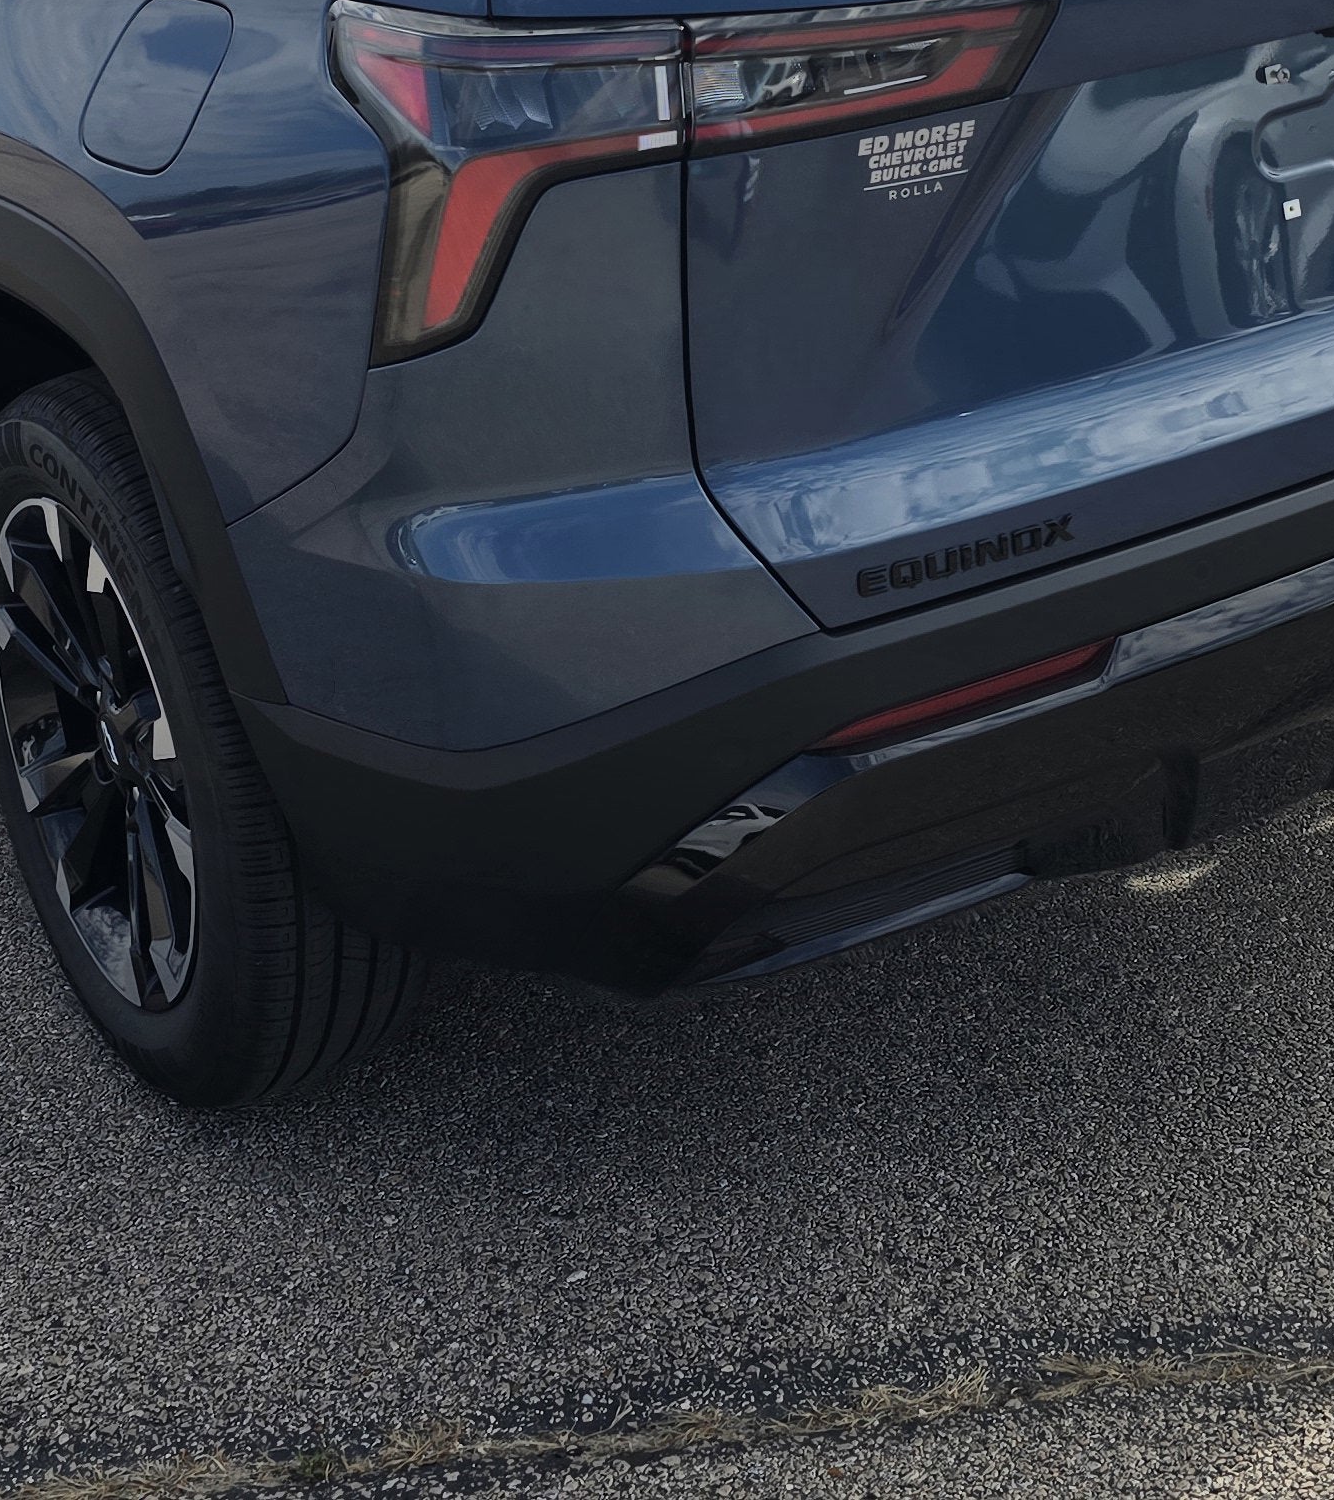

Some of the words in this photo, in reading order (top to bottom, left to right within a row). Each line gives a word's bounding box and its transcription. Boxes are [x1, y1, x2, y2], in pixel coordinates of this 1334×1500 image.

[858, 135, 889, 156] ED
[894, 120, 975, 150] MORSE
[868, 139, 967, 169] CHEVROLET
[888, 181, 943, 201] ROLLA
[856, 513, 1076, 599] EQUINOX
